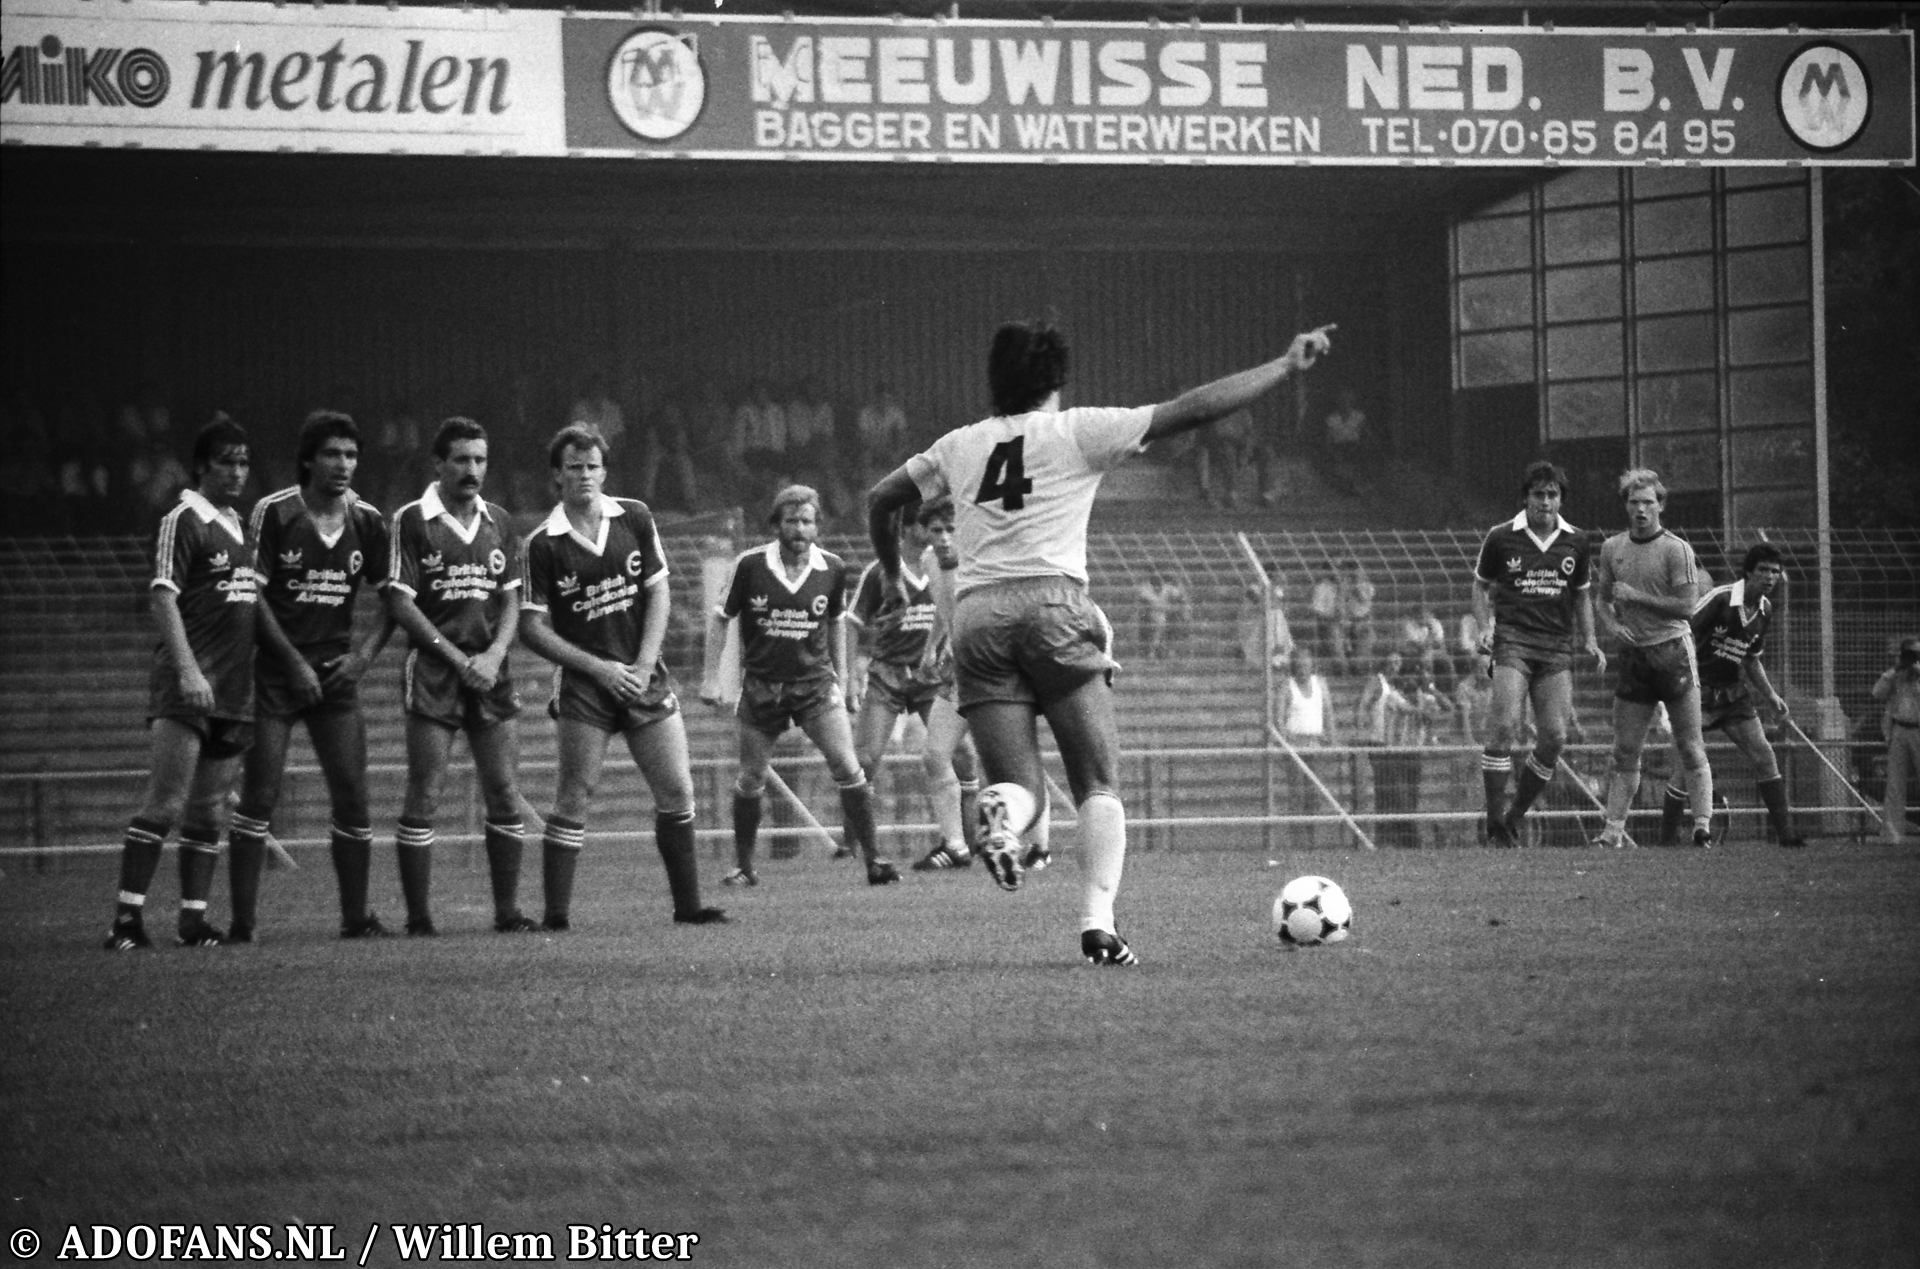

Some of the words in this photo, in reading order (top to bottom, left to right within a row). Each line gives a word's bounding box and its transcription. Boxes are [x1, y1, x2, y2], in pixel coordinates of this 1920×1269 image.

[190, 38, 513, 115] metalen
[749, 34, 1268, 108] MEEUWISSE
[1347, 44, 1542, 111] NED.
[754, 109, 932, 149] BAGGER
[944, 112, 1000, 150] EN
[1013, 113, 1321, 153] WATERWERKEN
[1613, 120, 1668, 155] 84
[1683, 119, 1736, 154] 95
[974, 434, 1033, 512] 4
